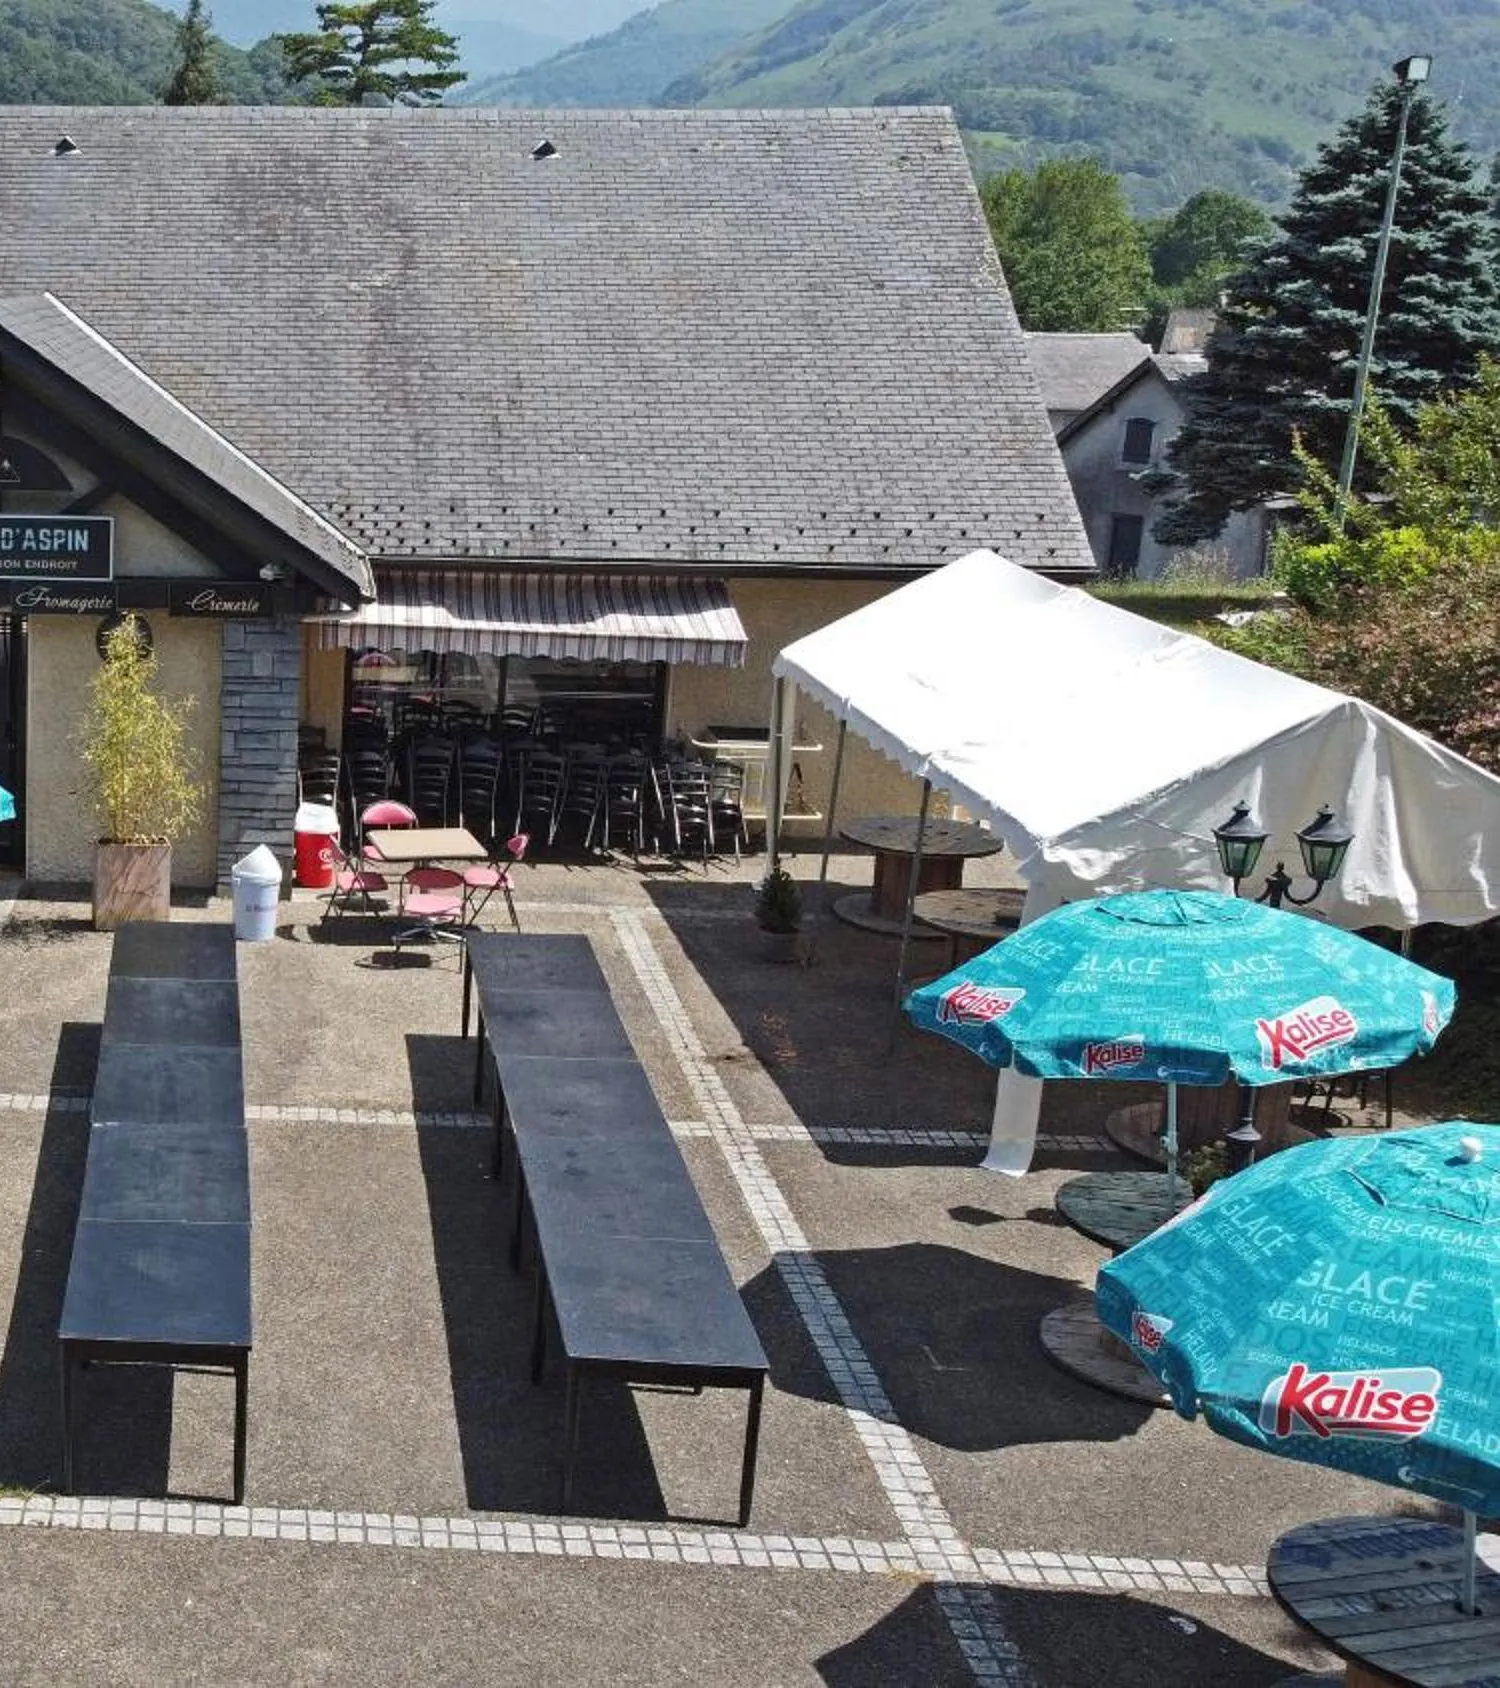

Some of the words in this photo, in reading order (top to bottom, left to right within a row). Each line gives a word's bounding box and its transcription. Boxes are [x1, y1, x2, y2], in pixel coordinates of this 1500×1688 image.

[1, 528, 89, 552] D'ASPIN
[24, 559, 79, 570] ENDROIT
[15, 585, 114, 613] Fromagerie
[944, 983, 1011, 1022] Kalise
[1257, 1009, 1351, 1069] Kalise
[1087, 1041, 1143, 1073] Kalise
[1218, 1195, 1298, 1257] GLACE
[1367, 1215, 1491, 1249] EISCREME
[1311, 1291, 1342, 1310] ICE
[1347, 1301, 1414, 1327] CREAM
[1275, 1364, 1436, 1438] Kalise
